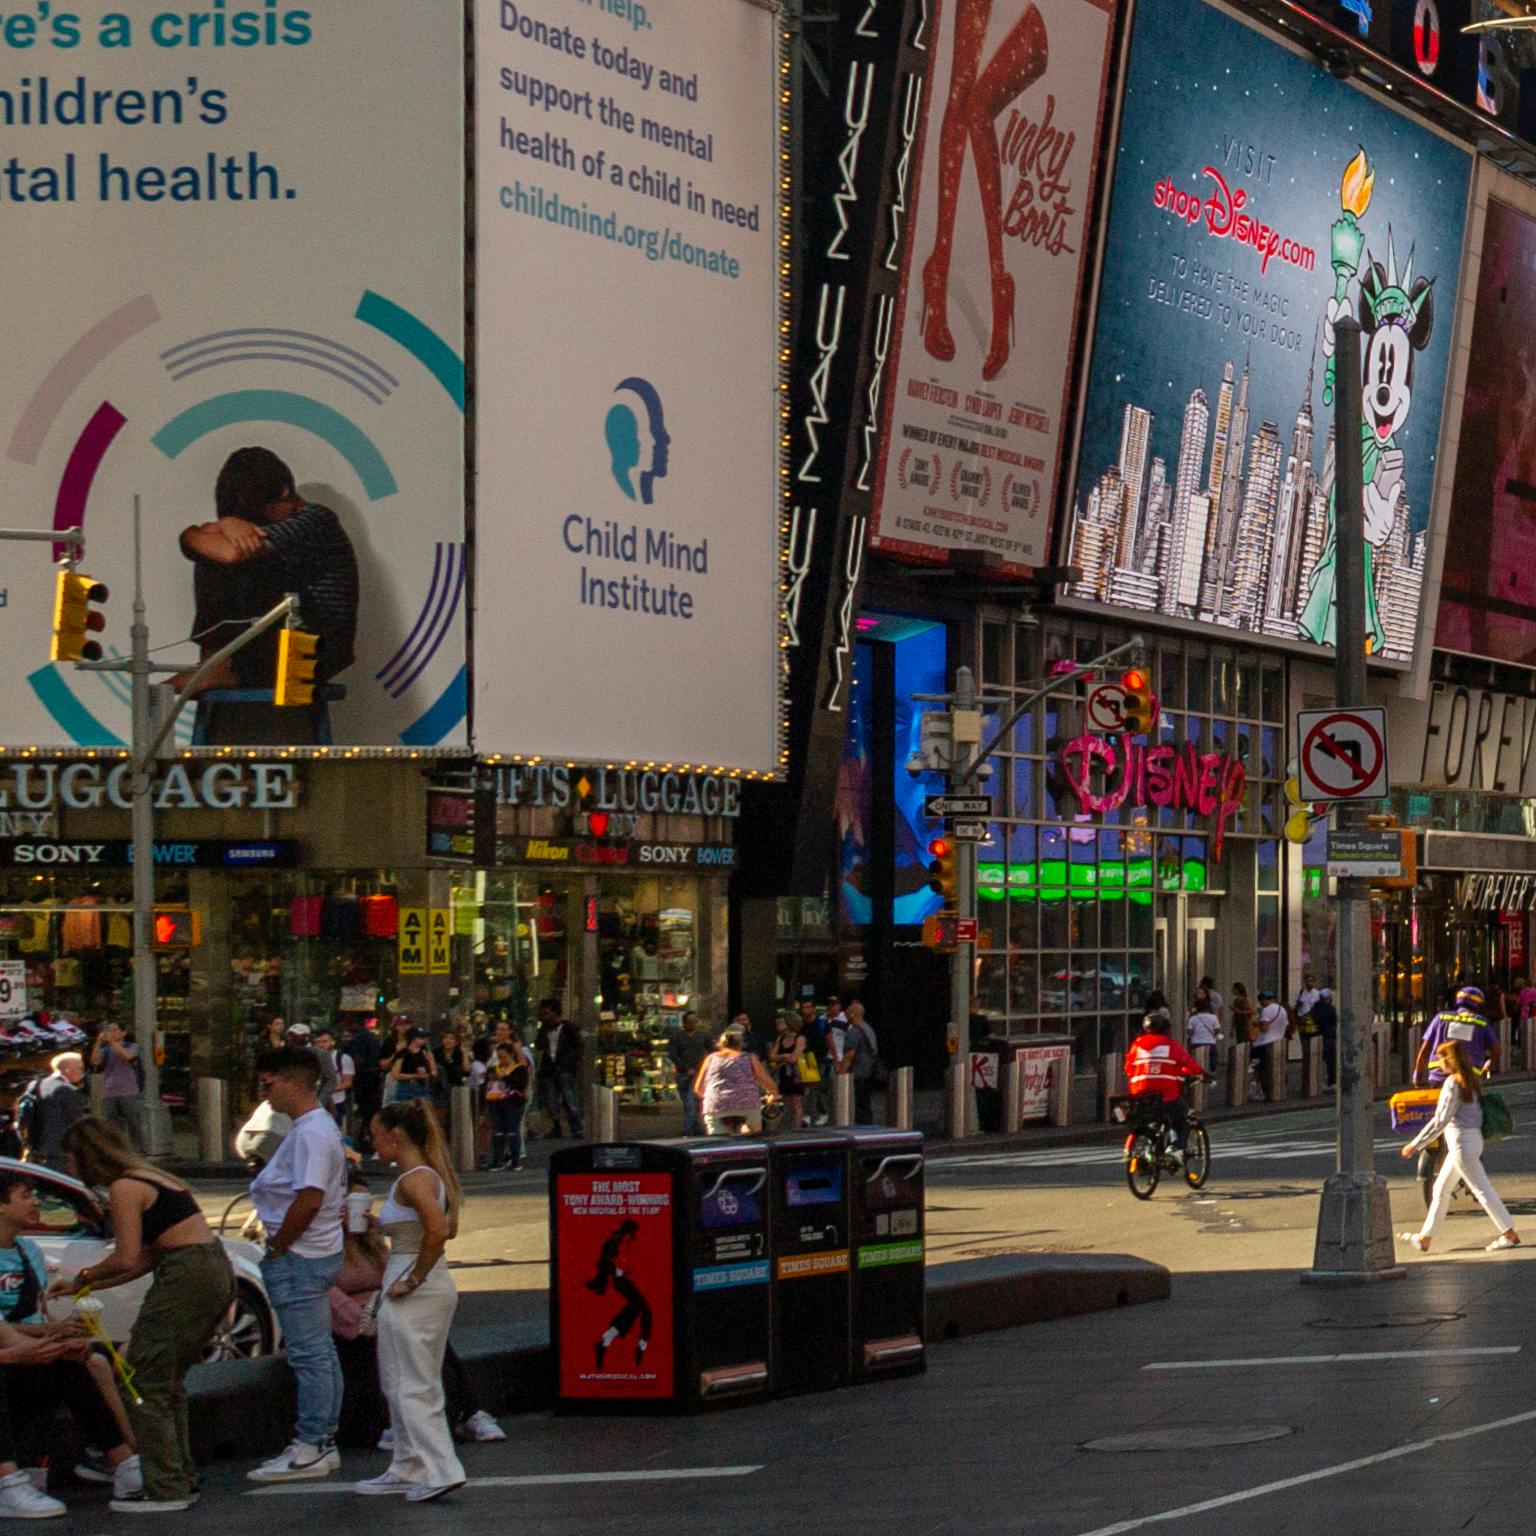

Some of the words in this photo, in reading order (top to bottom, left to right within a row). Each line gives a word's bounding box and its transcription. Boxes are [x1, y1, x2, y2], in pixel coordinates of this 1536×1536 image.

[98, 12, 131, 48] a
[591, 36, 655, 92] today
[658, 68, 698, 104] and
[499, 65, 592, 122] support
[597, 95, 635, 135] the
[641, 115, 714, 164] mental
[99, 151, 297, 202] health.
[499, 116, 576, 172] health
[582, 149, 606, 181] of
[610, 161, 624, 187] a
[628, 168, 682, 207] child
[686, 180, 706, 216] in
[711, 196, 760, 233] need
[1222, 132, 1277, 187] VISIT
[499, 179, 742, 280] childmind.org/donate
[1002, 177, 1077, 257] Boots
[1172, 252, 1188, 279] TO
[1192, 260, 1224, 294] HAVE
[1227, 275, 1250, 304] THE
[1253, 286, 1290, 320] MAGIC
[1147, 276, 1212, 321] DELIVERED
[1216, 302, 1232, 328] TO
[1237, 311, 1267, 340] YOUR
[1270, 322, 1303, 353] DOOR
[562, 513, 637, 563] Child
[645, 527, 708, 575] Mind
[580, 565, 695, 620] Institute
[596, 767, 742, 817] LUGGAGE
[962, 800, 984, 811] WAY
[13, 844, 105, 864] SONY
[228, 847, 276, 860] SAMSUNG
[525, 840, 569, 861] Nikon
[639, 845, 692, 863] SONY
[1329, 840, 1356, 851] Times
[1358, 841, 1390, 852] Square
[1462, 874, 1529, 911] FOREVER
[402, 913, 423, 965] ATM
[432, 913, 448, 963] ATM
[592, 1180, 611, 1194] THE
[612, 1180, 641, 1194] MOST
[693, 1272, 727, 1286] TIMES
[728, 1265, 770, 1283] SQUARE
[779, 1260, 812, 1276] TIMES
[812, 1254, 849, 1272] SQUARE
